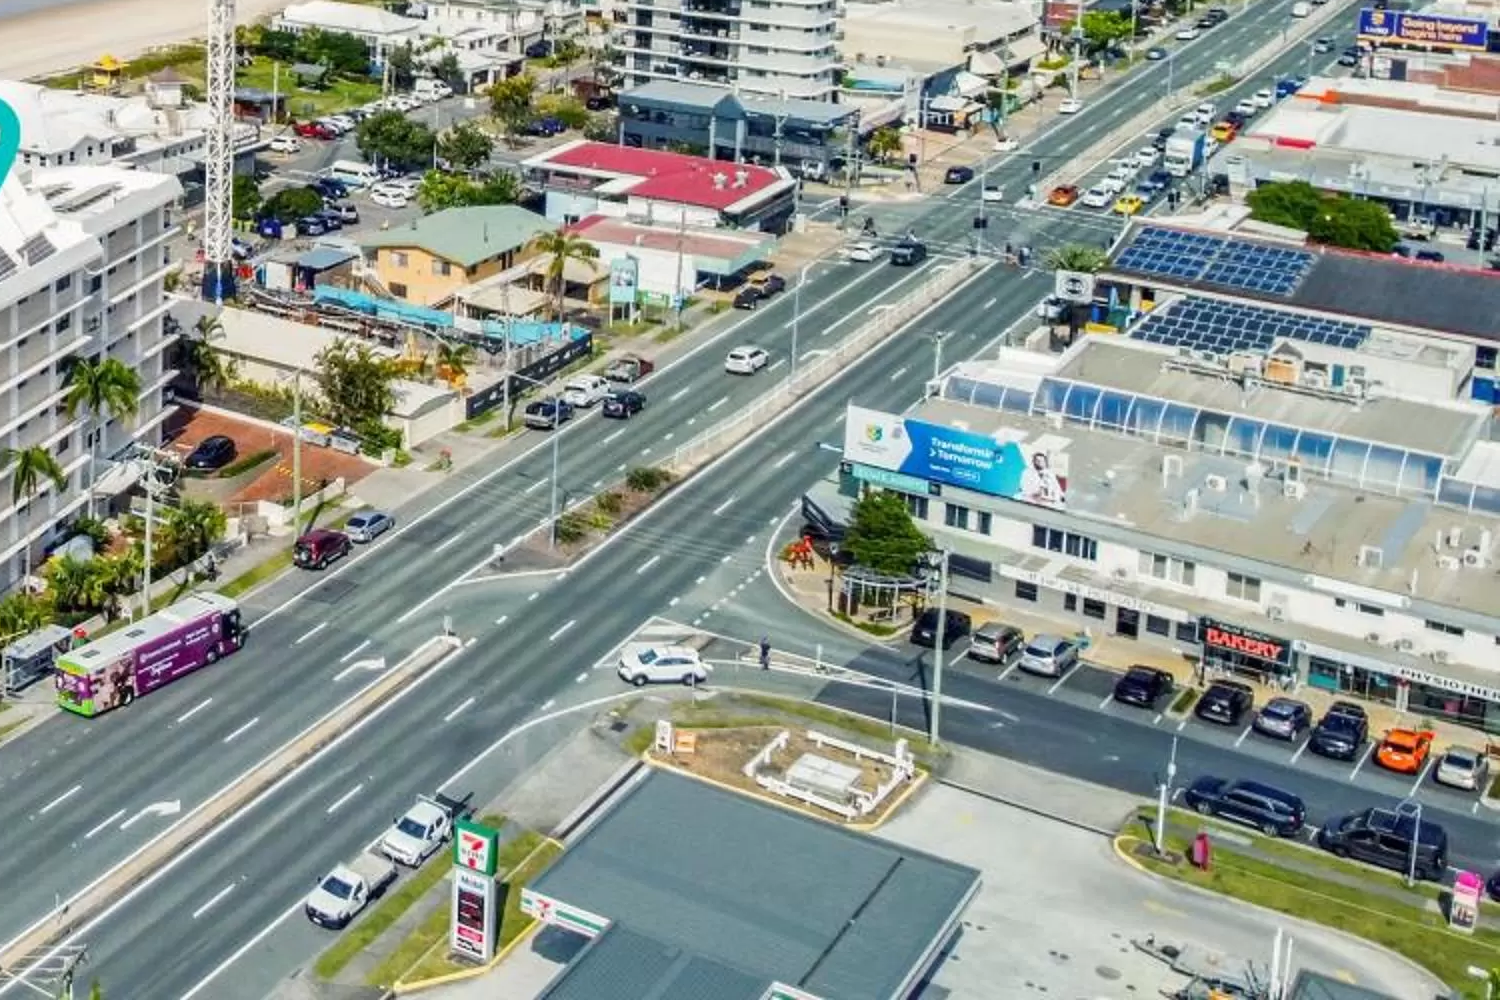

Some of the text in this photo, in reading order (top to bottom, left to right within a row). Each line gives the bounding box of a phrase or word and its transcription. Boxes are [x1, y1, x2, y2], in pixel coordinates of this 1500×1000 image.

[1401, 17, 1435, 30] Going
[1438, 19, 1478, 34] beyond
[1401, 28, 1437, 40] begins
[1438, 32, 1462, 42] here
[931, 437, 1003, 463] Transforming
[937, 449, 993, 469] Tomorrow
[1206, 627, 1283, 659] BAKERY
